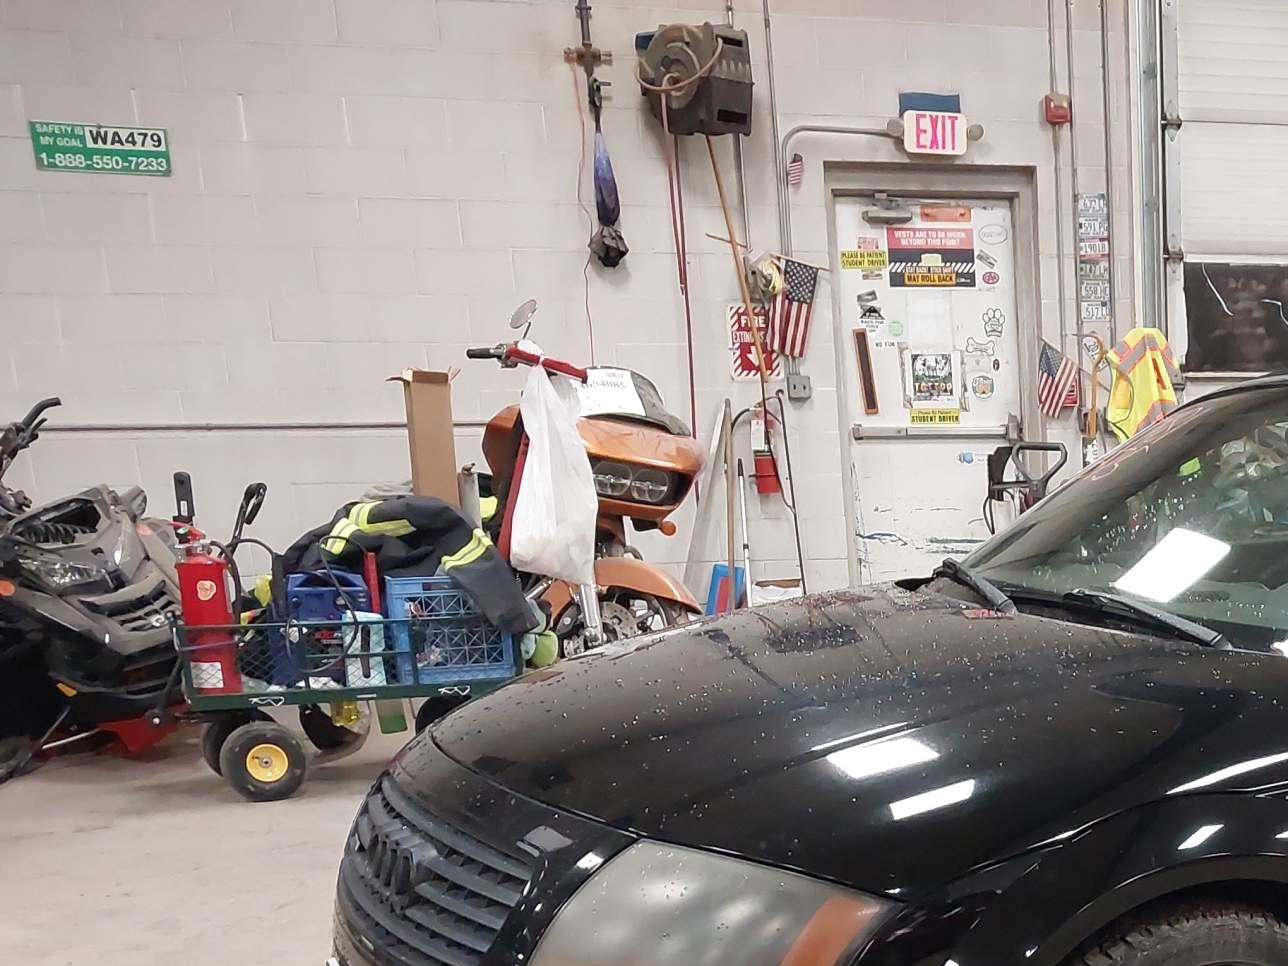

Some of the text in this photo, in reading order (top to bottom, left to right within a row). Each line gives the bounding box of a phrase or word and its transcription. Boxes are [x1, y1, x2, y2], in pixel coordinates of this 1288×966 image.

[35, 123, 73, 134] SAFETY
[914, 113, 959, 151] EXIT
[40, 135, 84, 148] MY GOAL
[88, 129, 163, 148] WA479
[39, 152, 168, 171] 1-888-550-7233
[914, 231, 927, 239] ARE
[927, 231, 937, 239] TO
[842, 259, 885, 267] STUDENT DRIVER
[907, 274, 920, 282] MAY
[920, 274, 938, 282] ROLL
